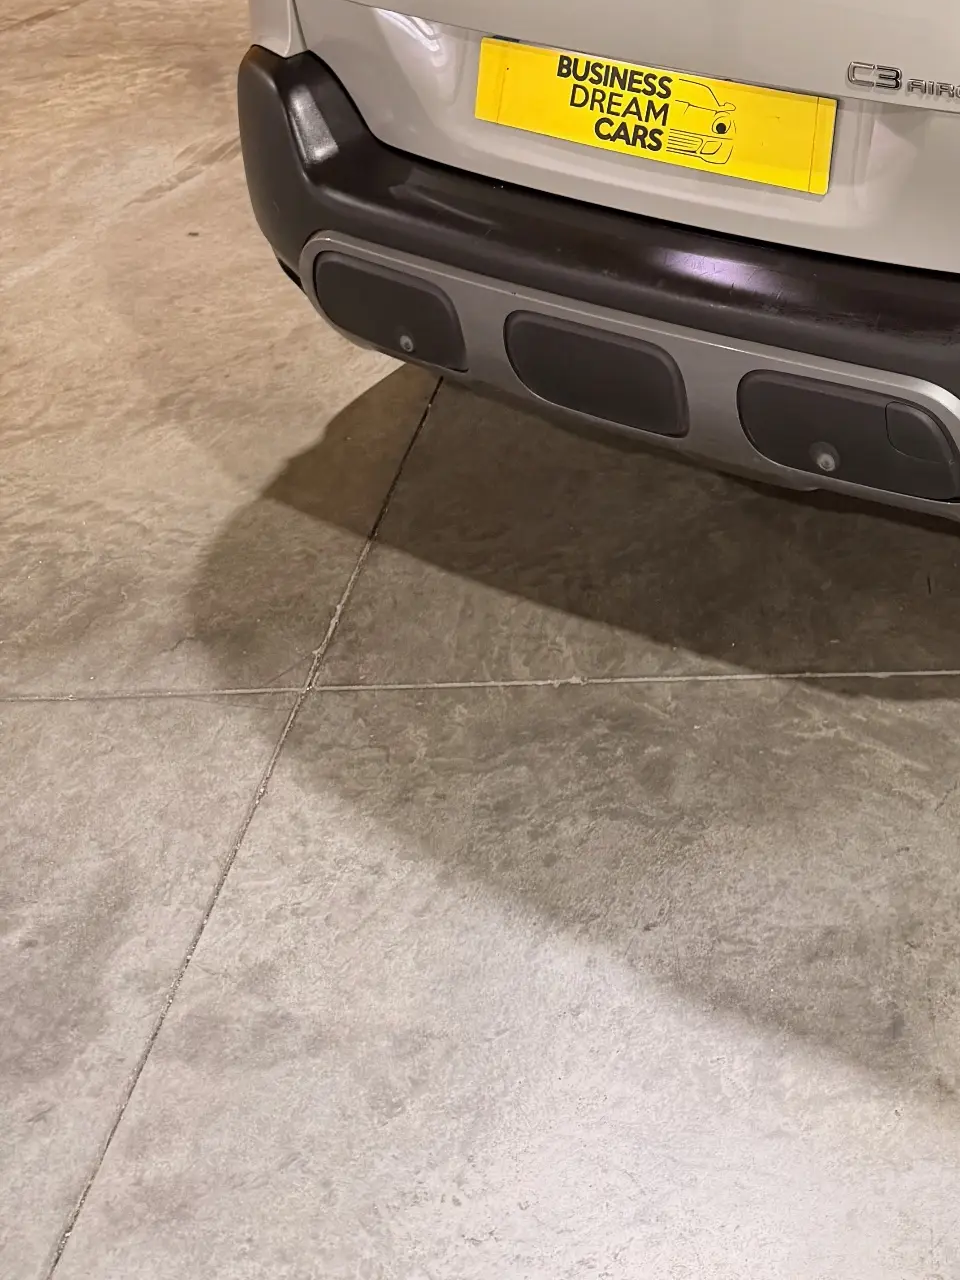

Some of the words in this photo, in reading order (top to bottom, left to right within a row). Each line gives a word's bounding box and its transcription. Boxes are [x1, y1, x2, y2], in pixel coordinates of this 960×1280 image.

[556, 54, 673, 99] BUSINESS
[847, 61, 903, 90] C3
[569, 84, 669, 126] DREAM
[594, 117, 663, 152] CARS
